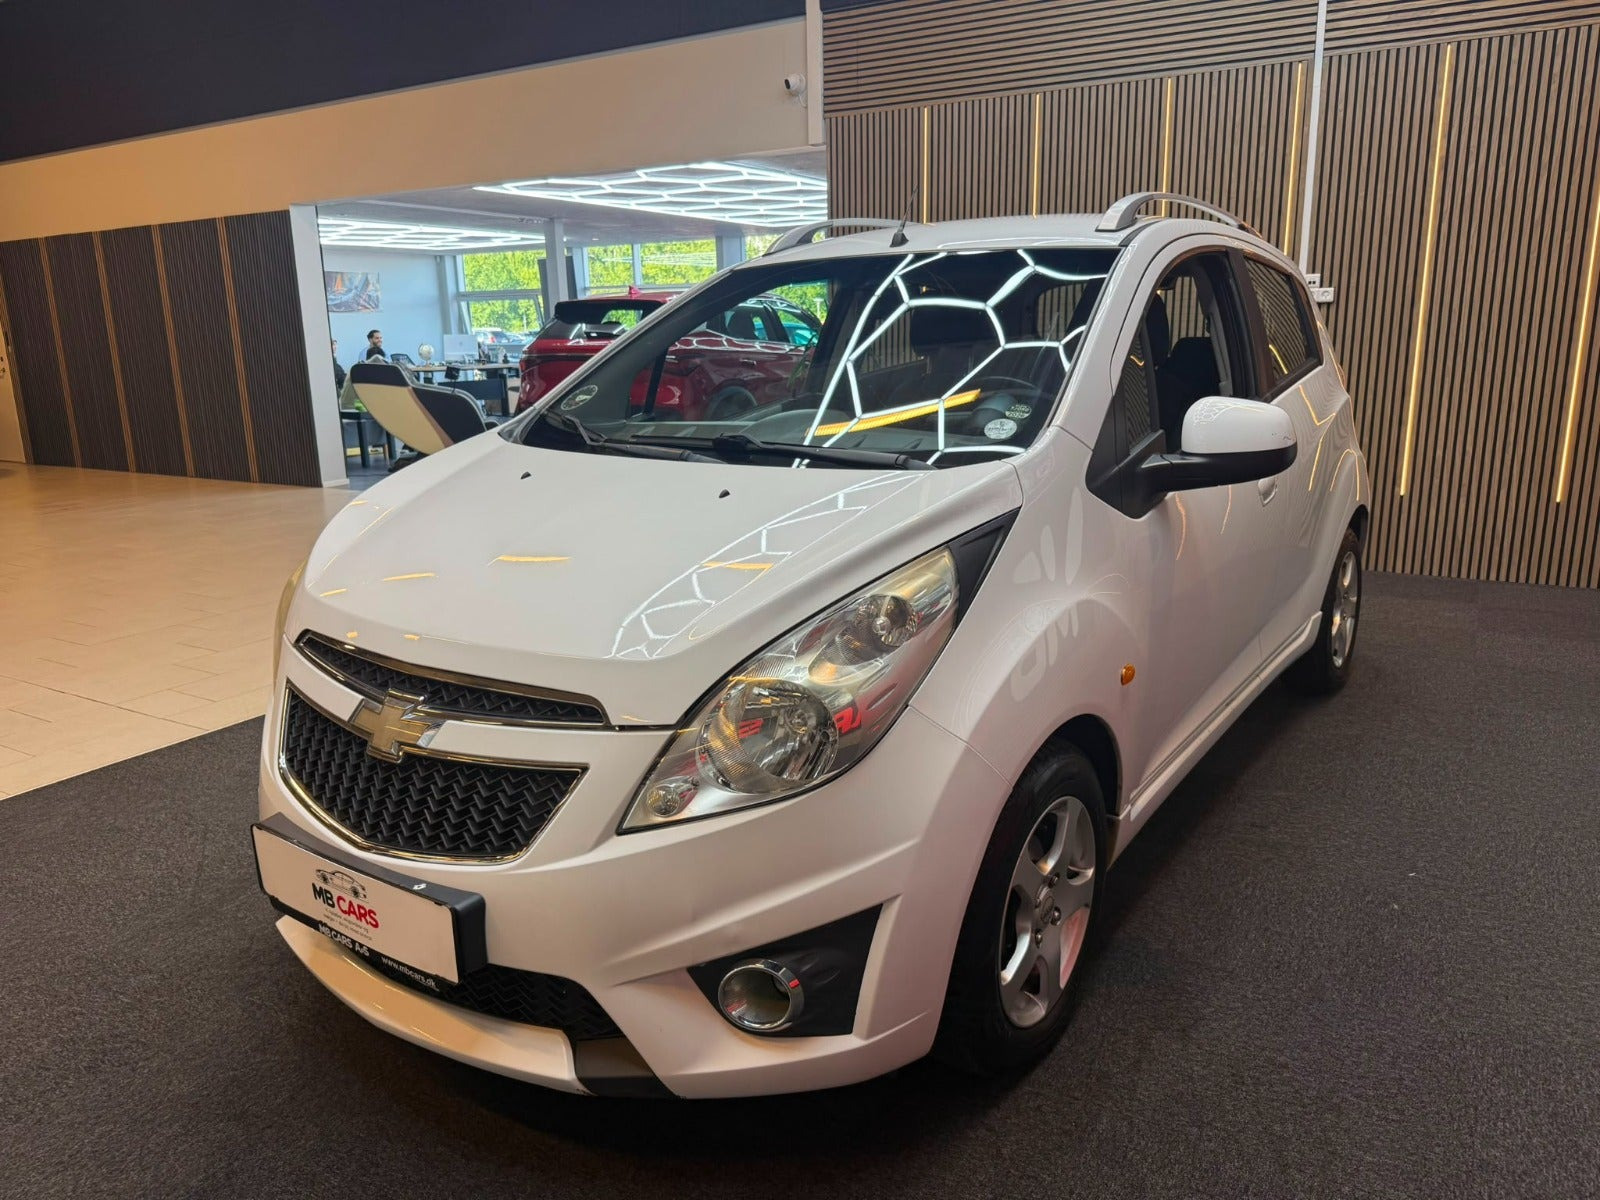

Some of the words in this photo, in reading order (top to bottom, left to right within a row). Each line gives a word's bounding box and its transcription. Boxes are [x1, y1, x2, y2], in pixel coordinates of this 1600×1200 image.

[312, 882, 335, 908] MB
[336, 895, 379, 928] CARS
[318, 923, 331, 938] MB
[331, 931, 353, 949] CARS
[381, 956, 437, 987] www.mbcars.dk
